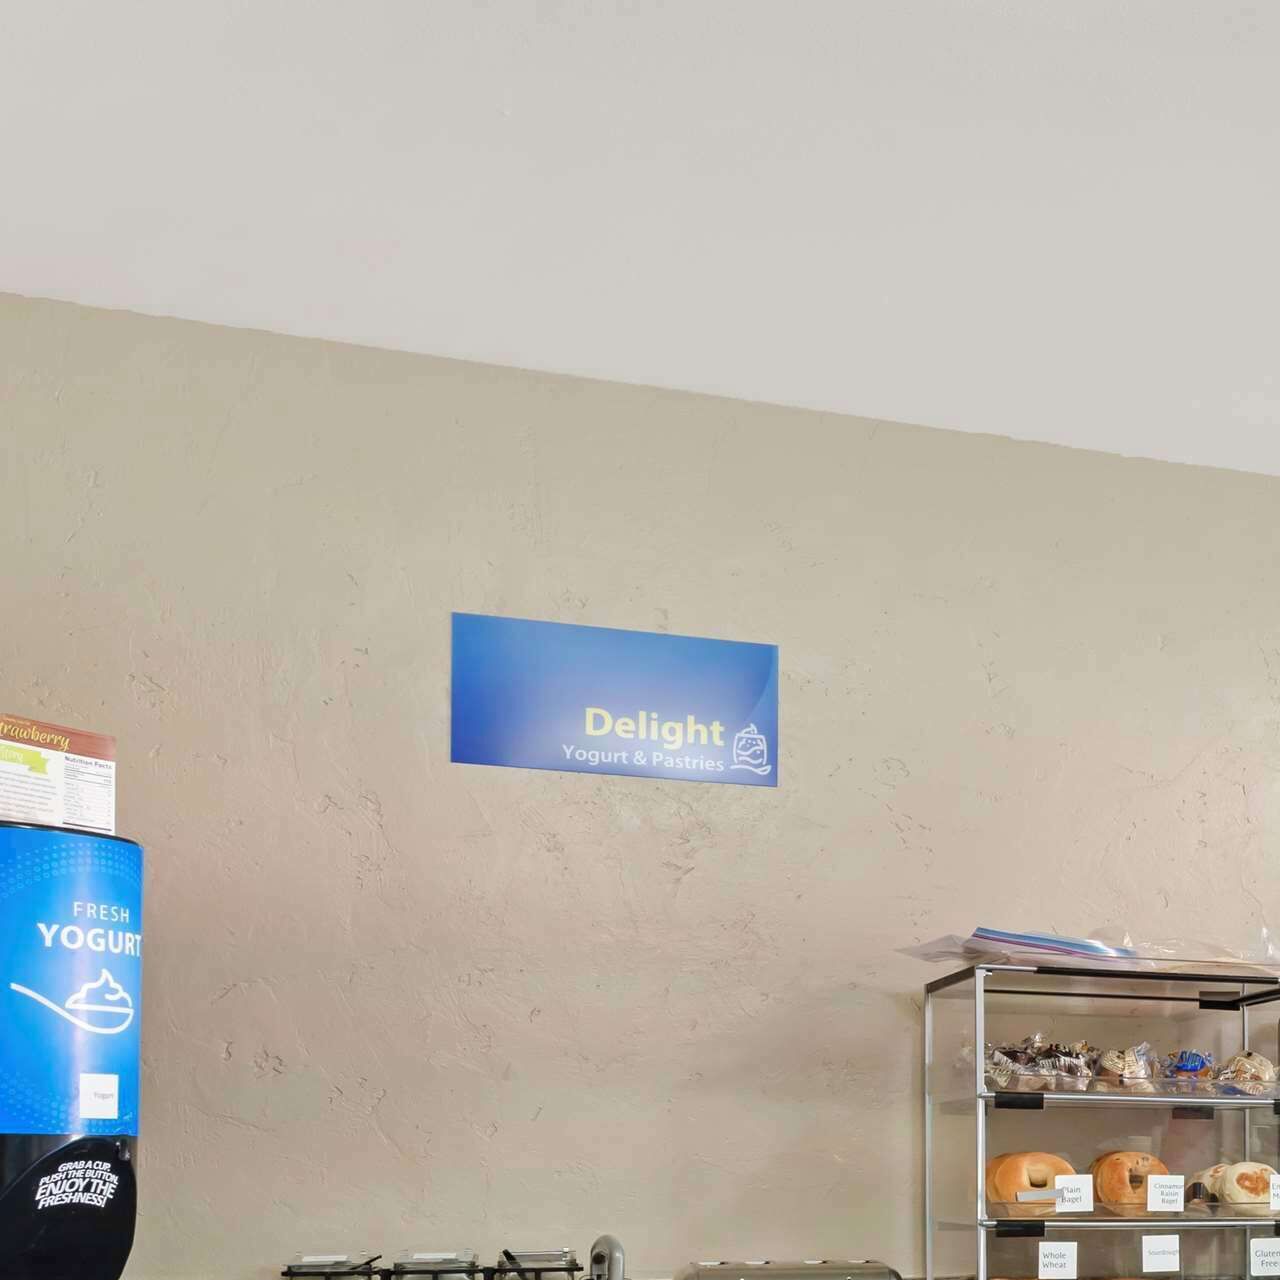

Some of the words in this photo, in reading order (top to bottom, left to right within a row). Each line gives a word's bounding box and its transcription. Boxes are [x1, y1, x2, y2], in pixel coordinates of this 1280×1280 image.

[0, 722, 71, 752] trawberry
[585, 706, 725, 749] Delight
[562, 744, 629, 766] Yogurt
[634, 750, 648, 766] &
[651, 751, 724, 772] Pastries
[73, 901, 130, 923] FRESH
[37, 922, 142, 957] YOGURT
[58, 1160, 85, 1172] GRAB
[84, 1160, 93, 1169] A
[39, 1172, 66, 1186] PUSH
[67, 1170, 86, 1180] THE
[35, 1178, 89, 1200] ENJOY
[90, 1178, 117, 1199] THE
[37, 1192, 107, 1210] FRESHNESS!
[1042, 1251, 1067, 1260] Whole
[1042, 1259, 1067, 1269] Wheat
[1260, 1259, 1279, 1268] Free
